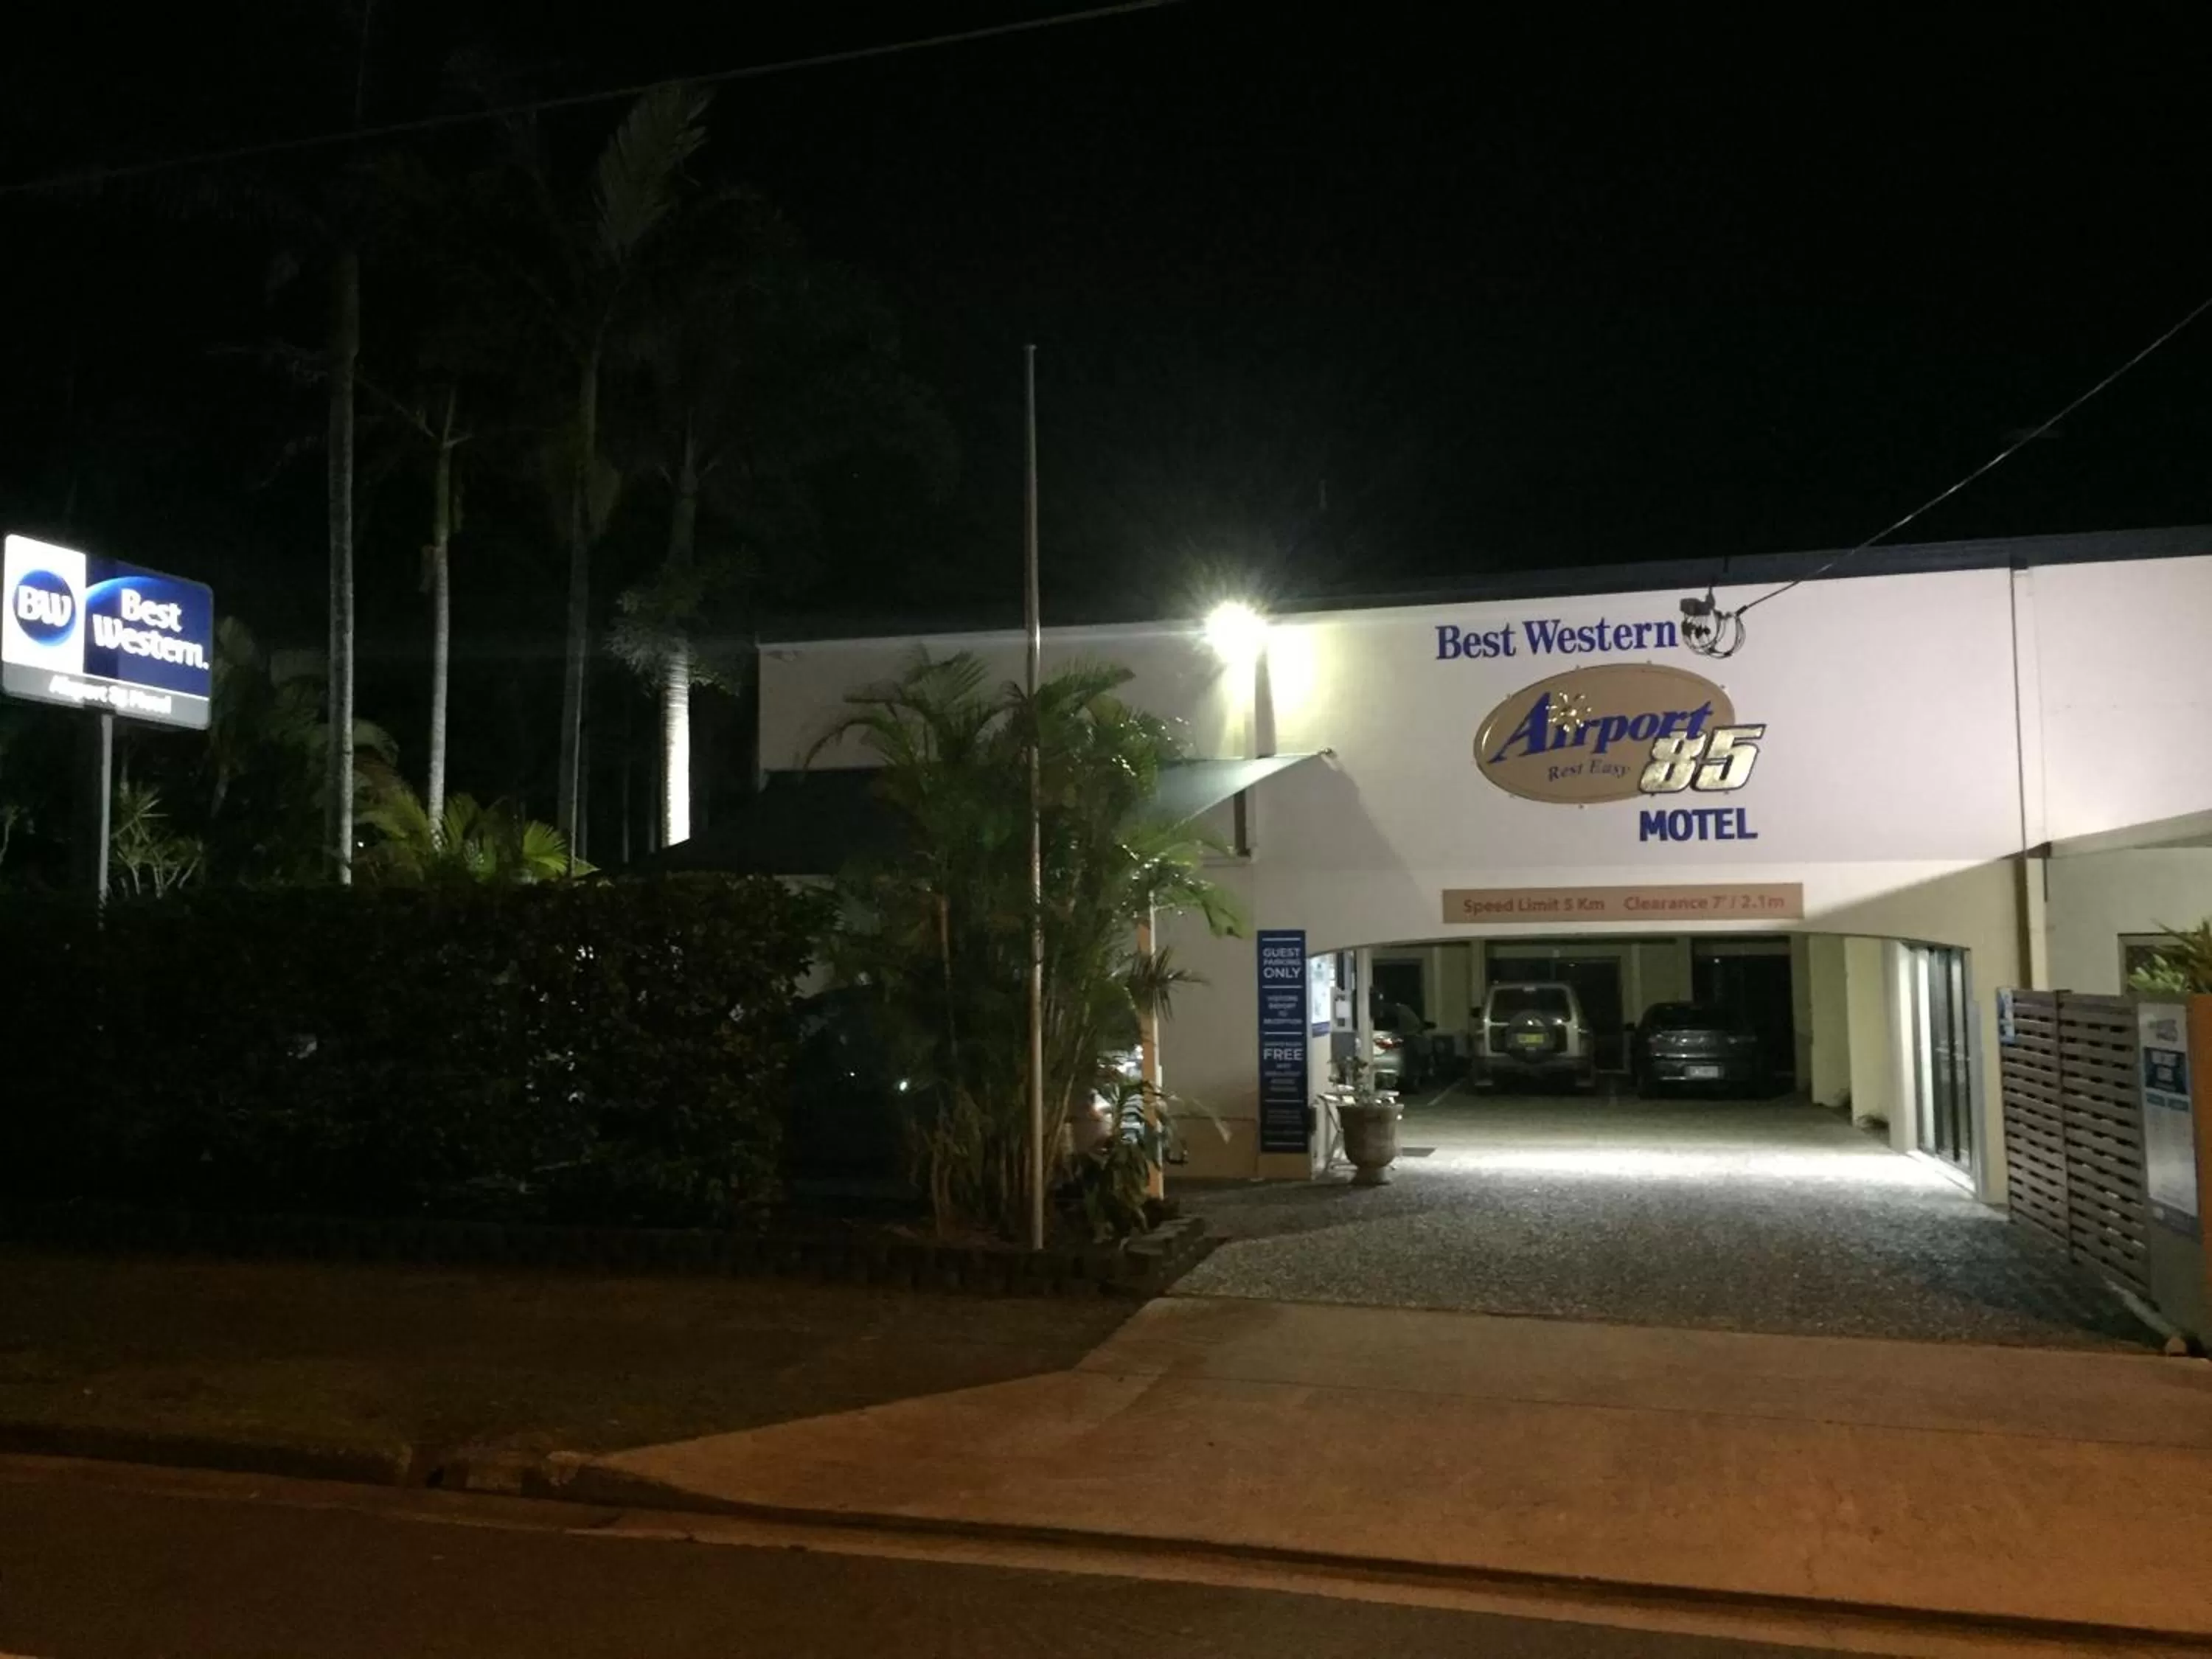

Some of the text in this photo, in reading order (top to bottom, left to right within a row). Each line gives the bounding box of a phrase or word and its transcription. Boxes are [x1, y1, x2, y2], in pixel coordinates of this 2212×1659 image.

[18, 585, 72, 627] BW
[120, 588, 182, 632] Best
[1436, 616, 1679, 660] Best Western
[1486, 692, 1714, 765] Airport
[1548, 759, 1631, 782] Rest Easy
[1638, 723, 1767, 794] 85
[1638, 807, 1759, 842] MOTEL
[1463, 897, 1514, 916] Speed
[1517, 897, 1559, 912] Limit
[1563, 897, 1573, 911] 5
[1577, 897, 1605, 911] Km
[1623, 895, 1708, 911] Clearance
[1741, 894, 1786, 909] 2.1m
[1262, 947, 1301, 958] GUEST
[1262, 967, 1301, 979] ONLY
[1263, 1048, 1304, 1061] FREE
